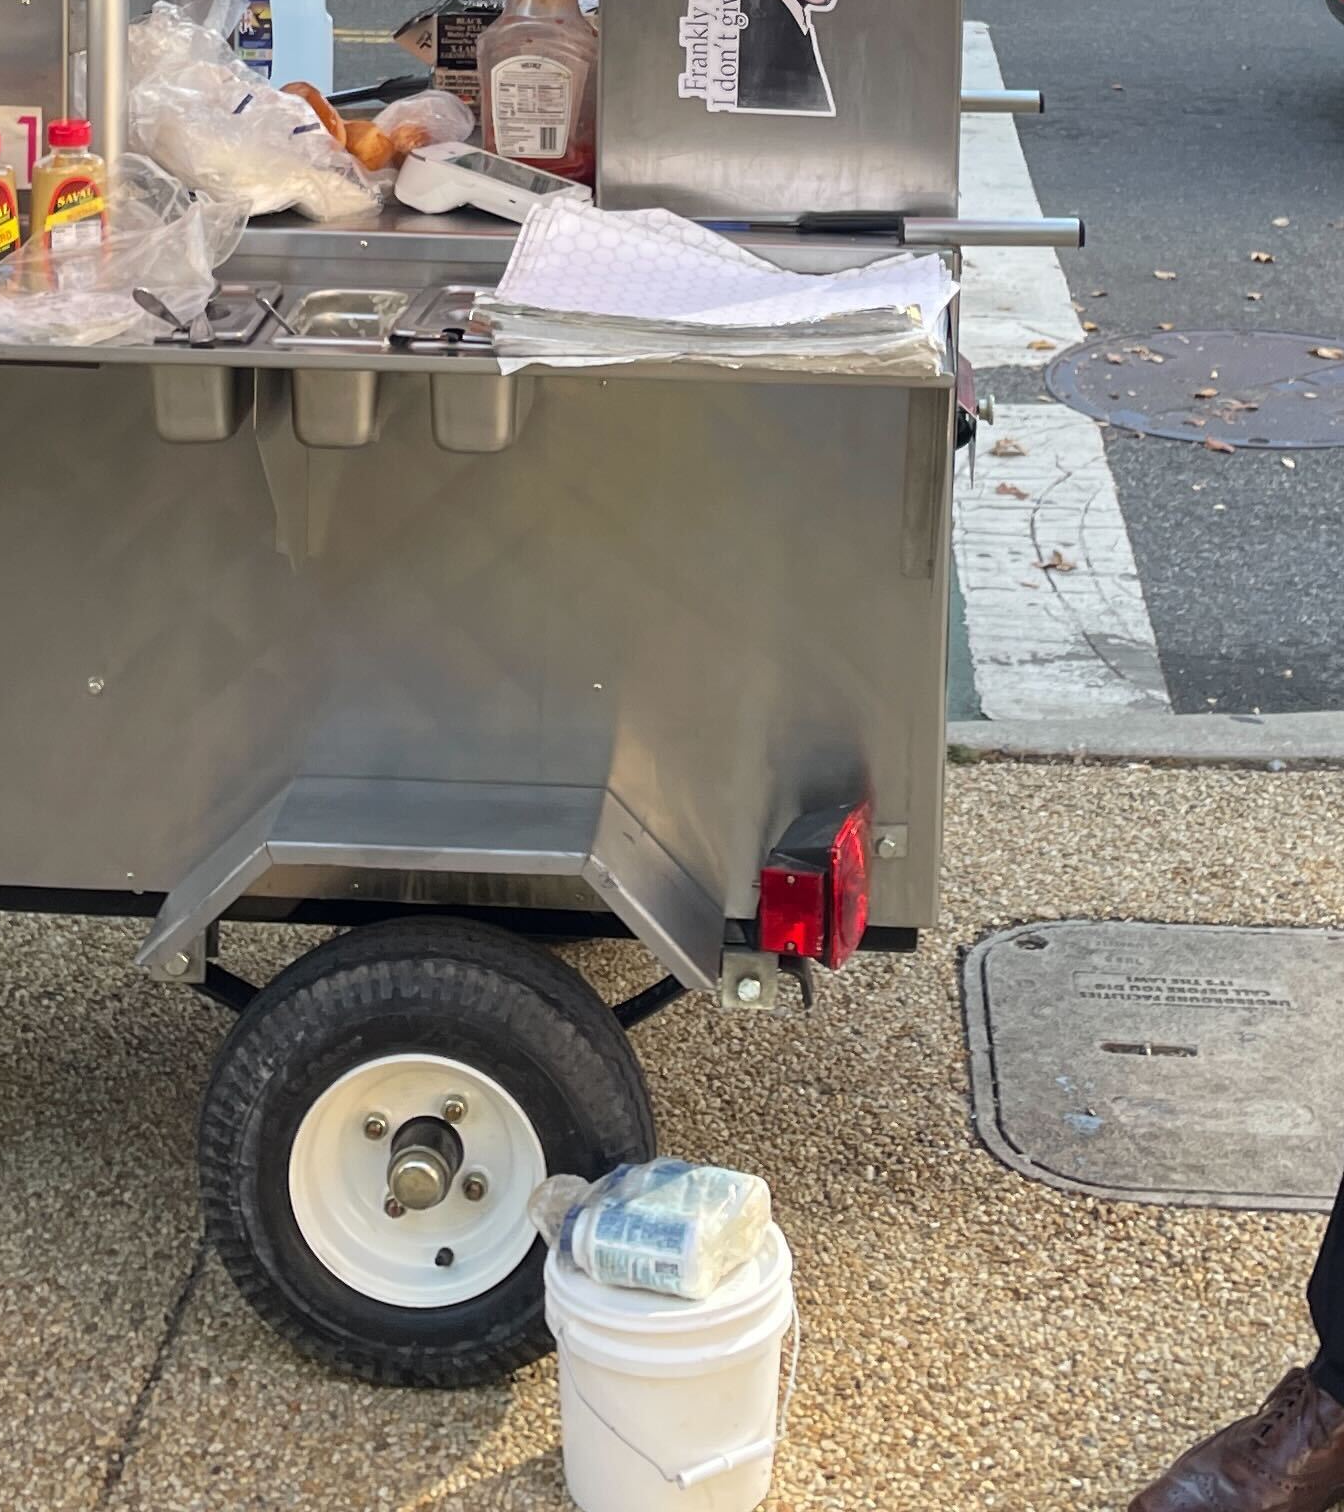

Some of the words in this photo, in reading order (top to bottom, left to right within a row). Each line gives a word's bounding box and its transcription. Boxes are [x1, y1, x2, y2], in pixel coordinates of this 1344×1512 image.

[684, 6, 718, 93] Frankly
[713, 98, 736, 106] I
[55, 188, 95, 208] SAVAL
[1129, 985, 1163, 994] YOU
[1167, 986, 1229, 996] BEFORE
[1231, 988, 1271, 997] CALL
[1079, 991, 1161, 1002] FACILITIES
[1165, 995, 1291, 1007] UNDERGROUND
